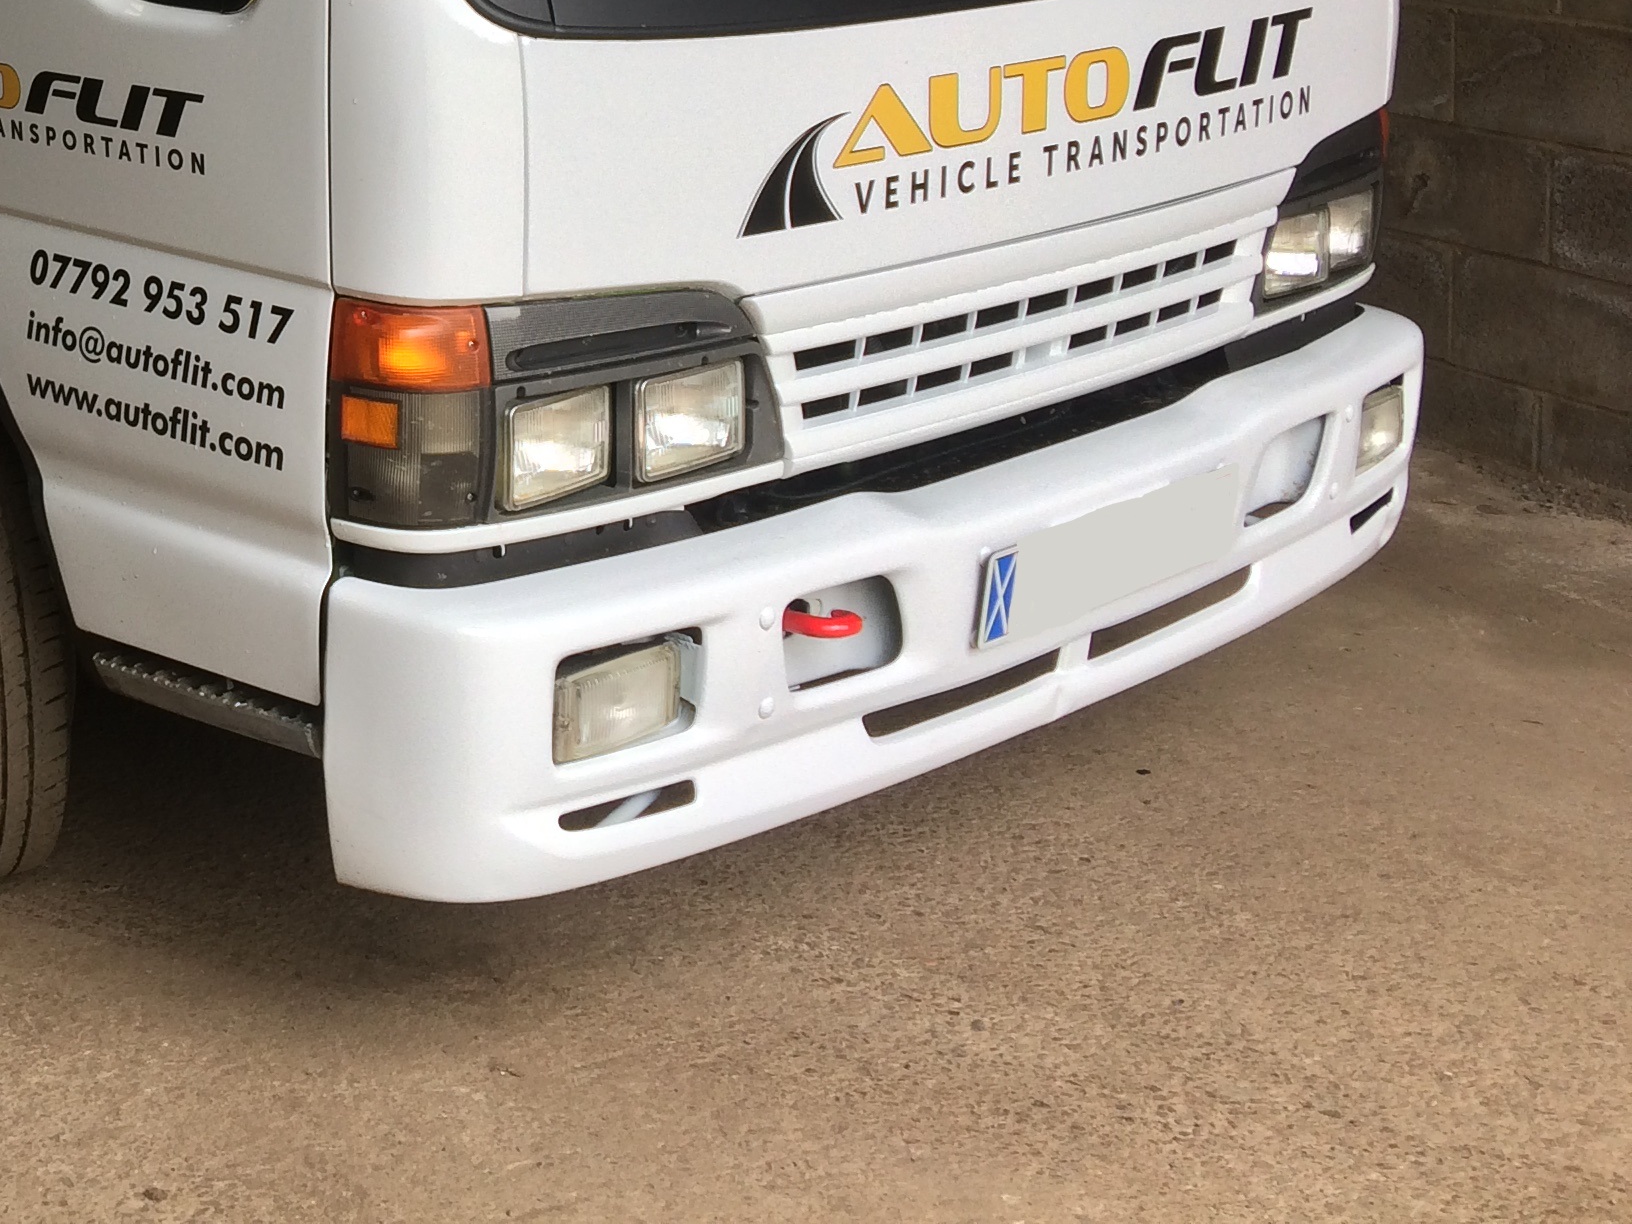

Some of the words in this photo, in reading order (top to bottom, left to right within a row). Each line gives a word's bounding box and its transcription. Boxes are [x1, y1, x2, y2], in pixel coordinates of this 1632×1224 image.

[854, 149, 1022, 215] VEHICLE
[1043, 84, 1313, 176] TRANSPORTATION
[29, 248, 130, 308] 07792
[142, 274, 206, 327] 953
[218, 295, 295, 345] 517
[26, 312, 286, 409] info@autoflit.com
[26, 374, 285, 471] www.autoflit.com
